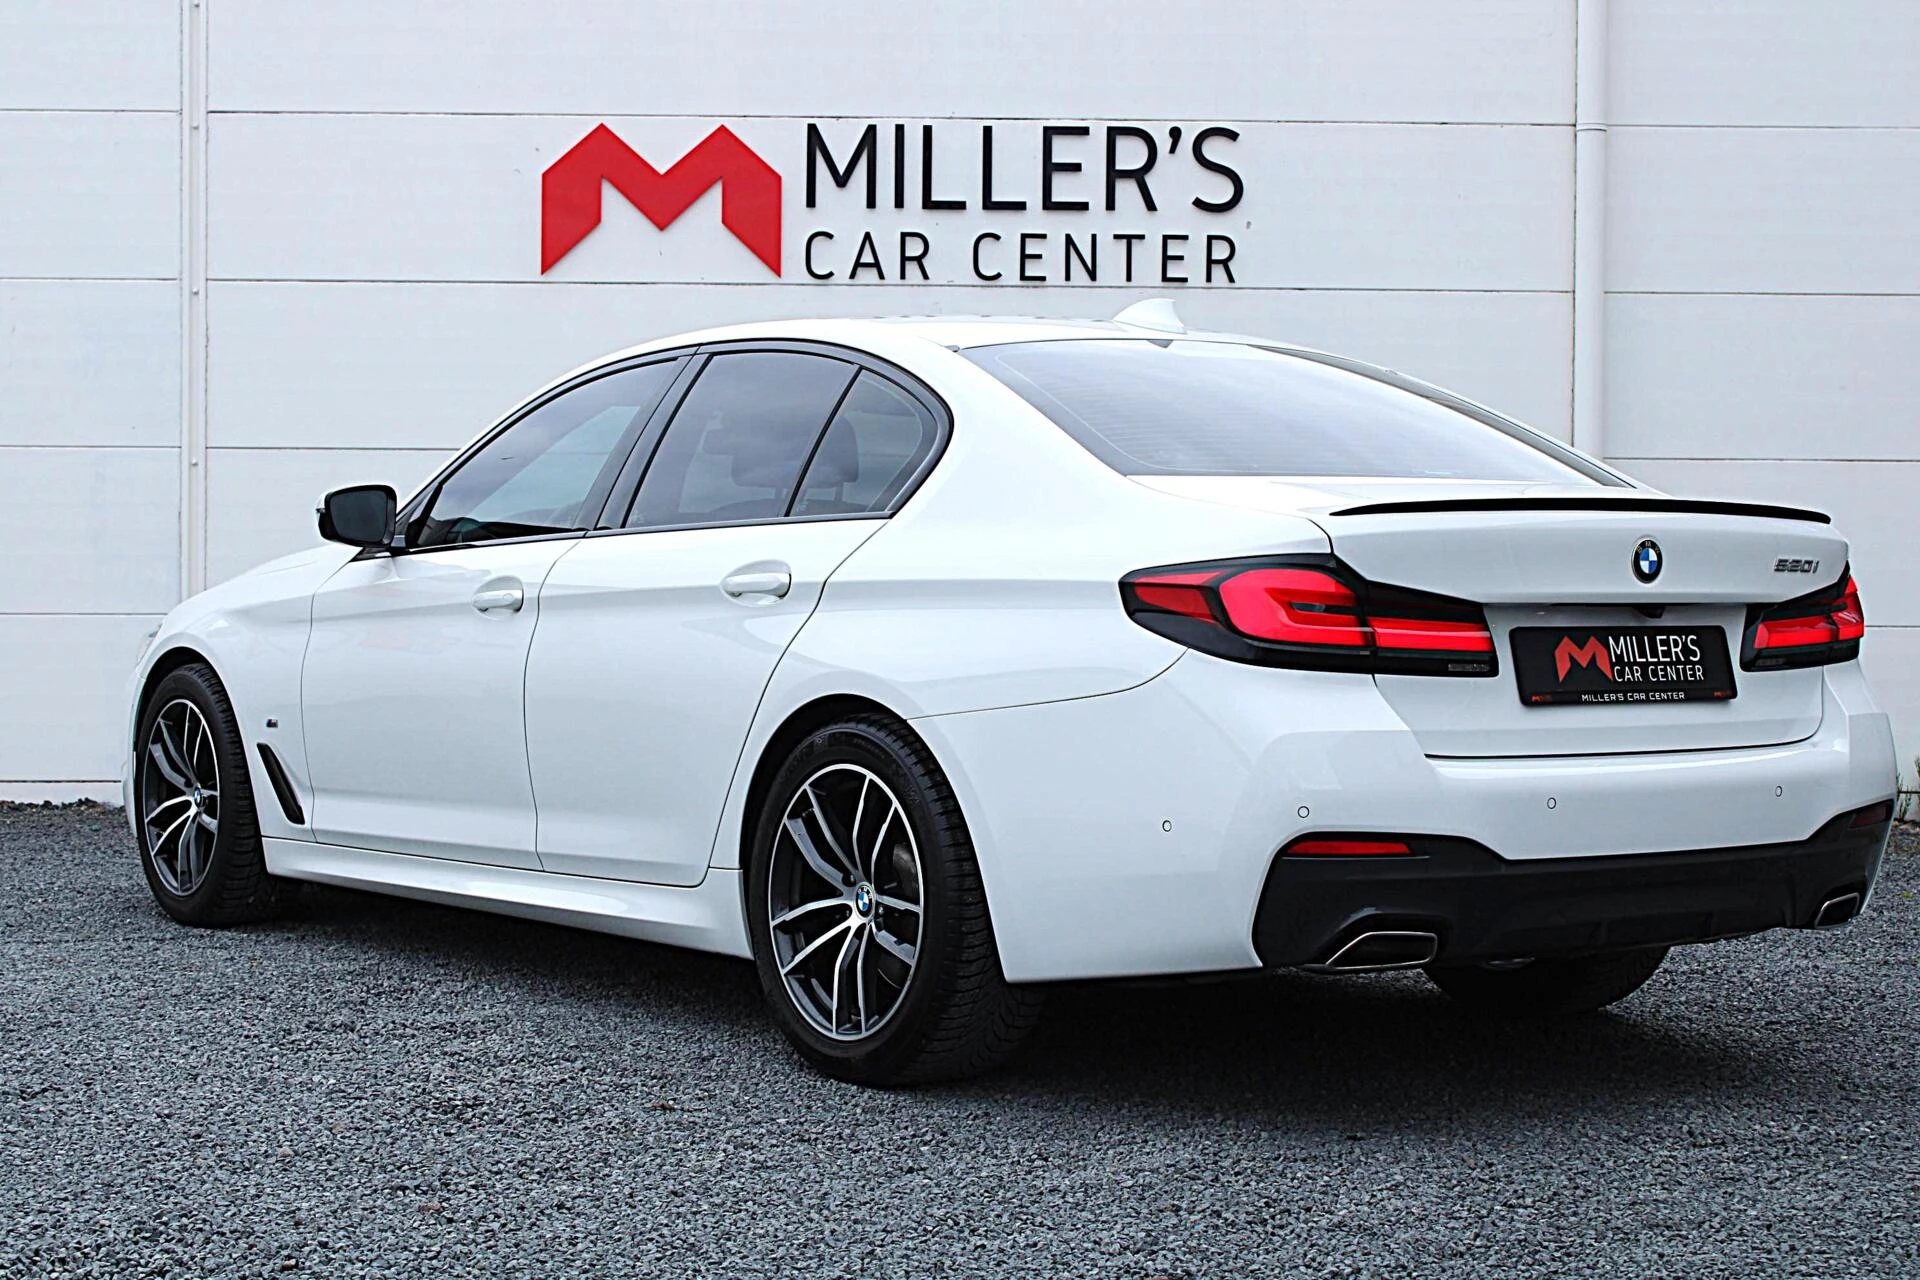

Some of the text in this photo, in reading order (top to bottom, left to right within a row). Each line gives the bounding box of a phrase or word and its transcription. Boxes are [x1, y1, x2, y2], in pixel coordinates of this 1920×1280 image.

[805, 122, 1244, 213] MILLER'S
[804, 230, 1237, 284] CAR CENTER
[1608, 634, 1701, 663] MILLER'S
[1613, 664, 1704, 682] CAR CENTER
[1627, 692, 1646, 701] CAR
[1648, 691, 1685, 700] CENTER
